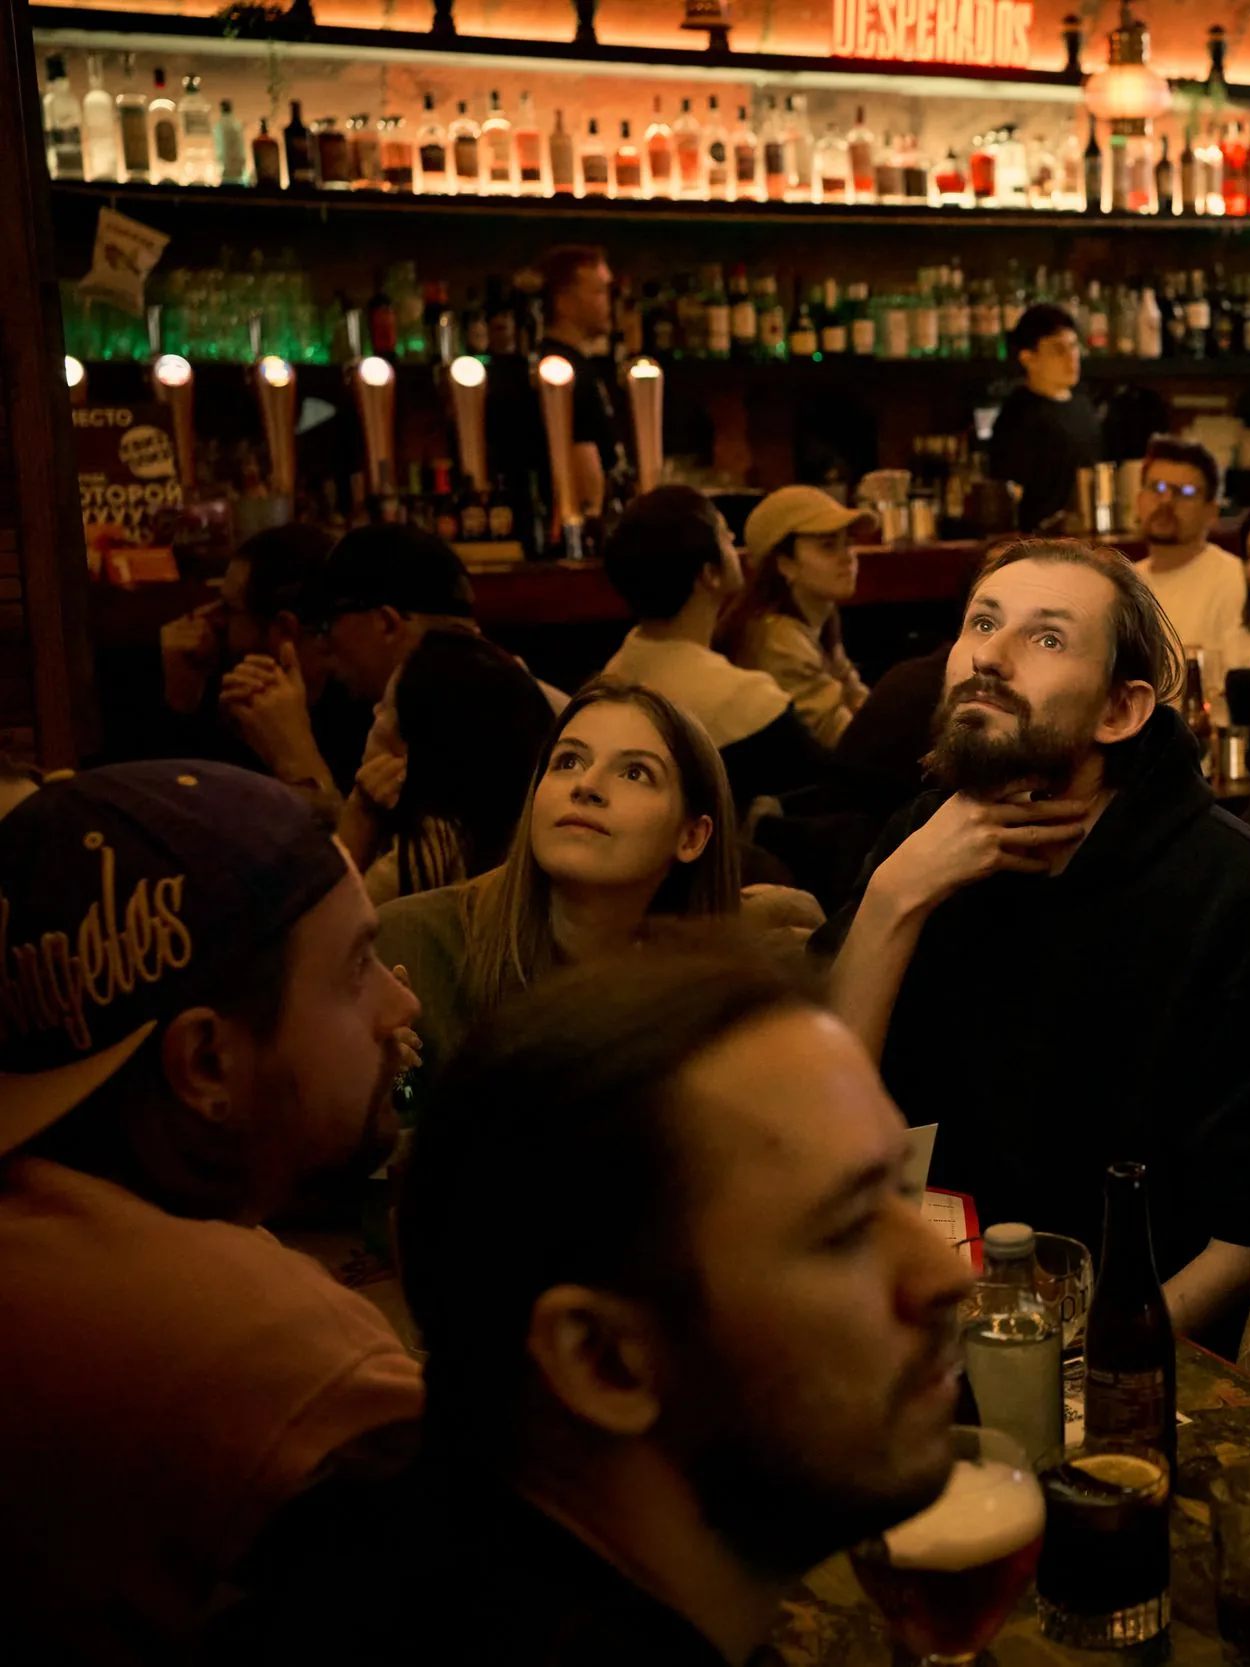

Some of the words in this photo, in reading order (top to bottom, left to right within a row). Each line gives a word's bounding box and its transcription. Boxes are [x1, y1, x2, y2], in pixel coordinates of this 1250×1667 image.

[832, 0, 1032, 69] DESPERADOS
[72, 407, 134, 428] ЕСТО
[0, 830, 192, 1050] ngeles
